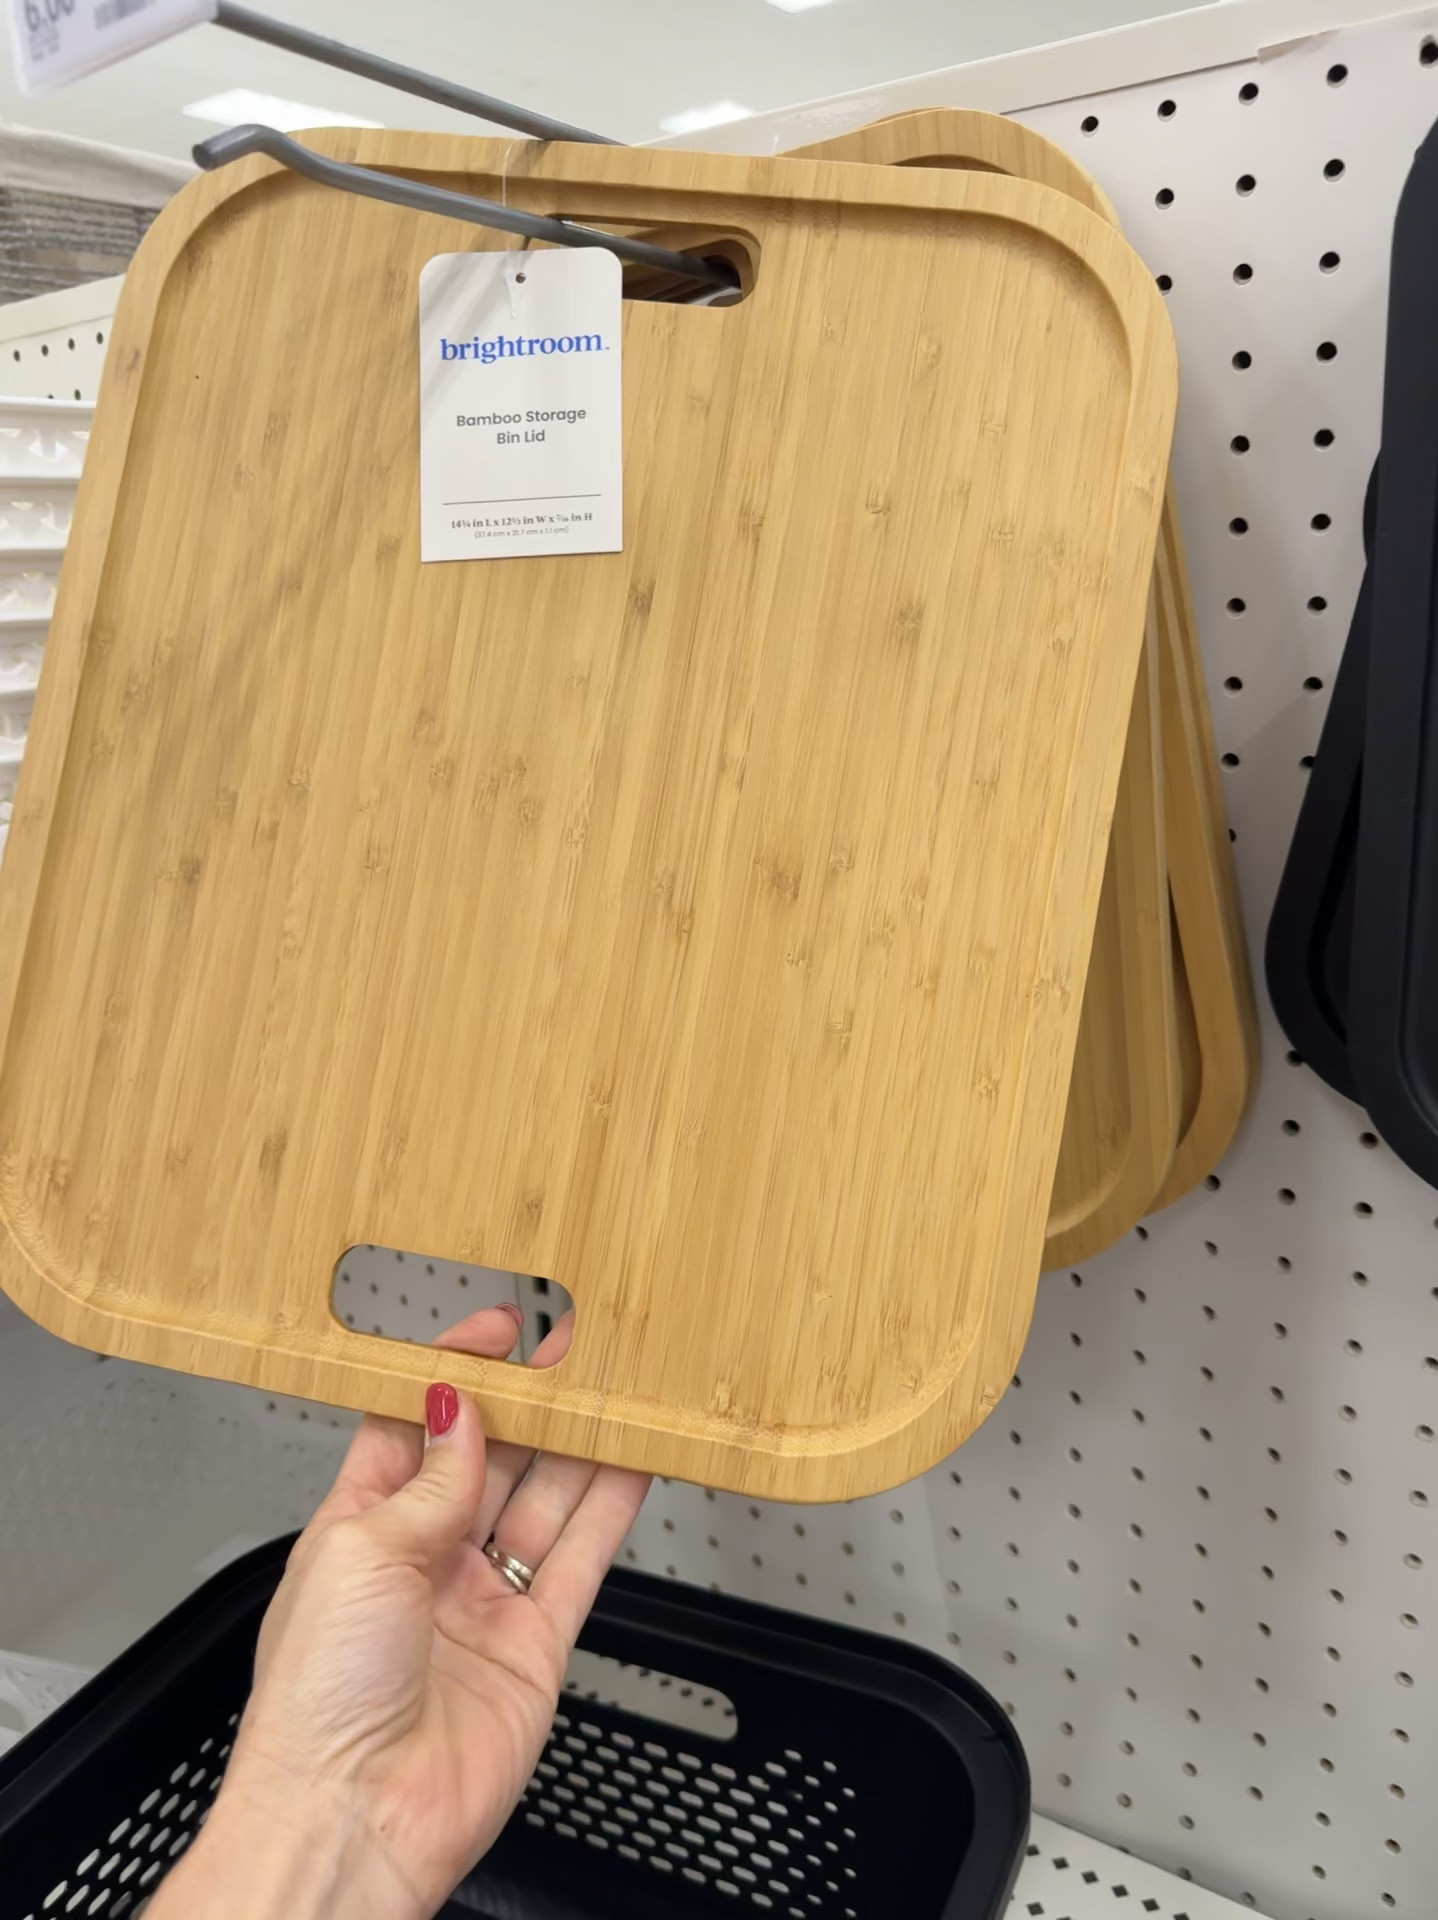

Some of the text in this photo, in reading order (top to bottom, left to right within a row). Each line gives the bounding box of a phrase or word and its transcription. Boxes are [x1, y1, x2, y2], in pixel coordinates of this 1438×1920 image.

[456, 407, 587, 427] Bamboo Storage
[496, 429, 546, 445] Bin Lid
[472, 518, 484, 528] in
[485, 518, 492, 527] L
[493, 519, 500, 527] x
[523, 515, 534, 525] in
[536, 515, 547, 524] W
[570, 513, 582, 522] in
[584, 512, 593, 521] H
